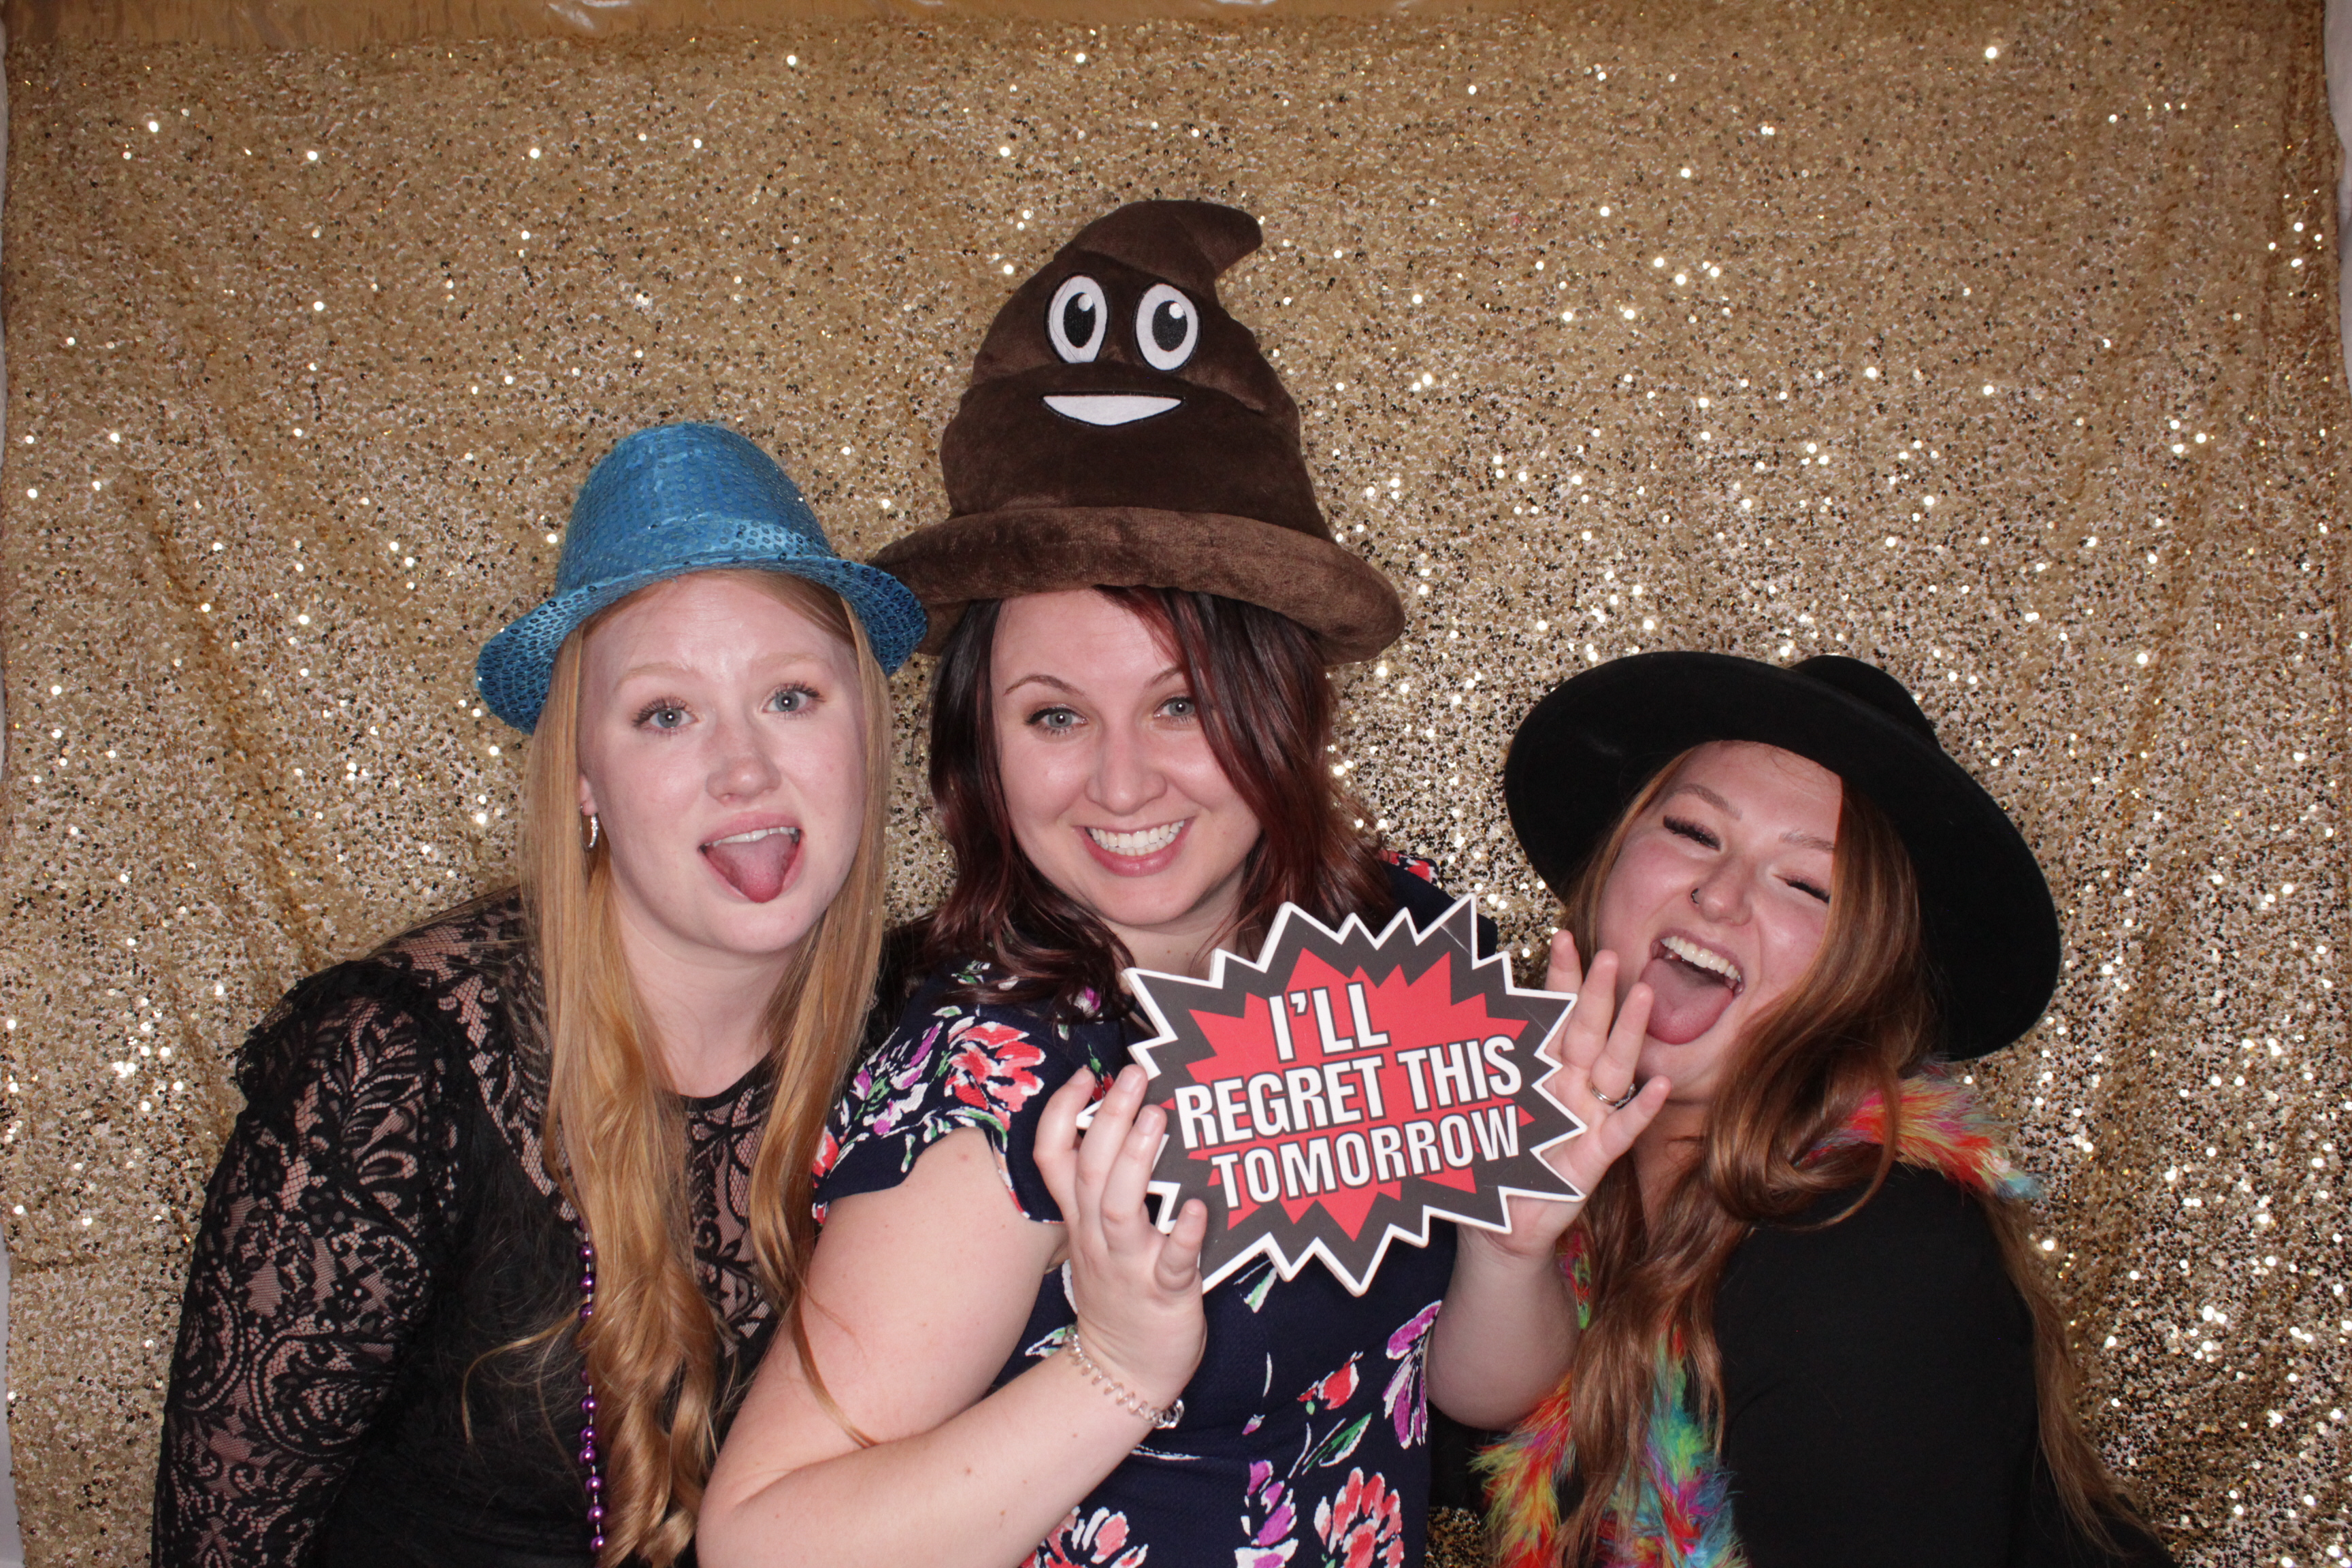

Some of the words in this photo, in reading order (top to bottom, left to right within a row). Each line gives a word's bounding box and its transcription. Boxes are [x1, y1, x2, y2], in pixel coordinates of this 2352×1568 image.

[1269, 984, 1389, 1061] I'LL
[1175, 1056, 1383, 1149] REGRET
[1397, 1036, 1522, 1111] THIS
[1211, 1105, 1519, 1208] TOMORROW
